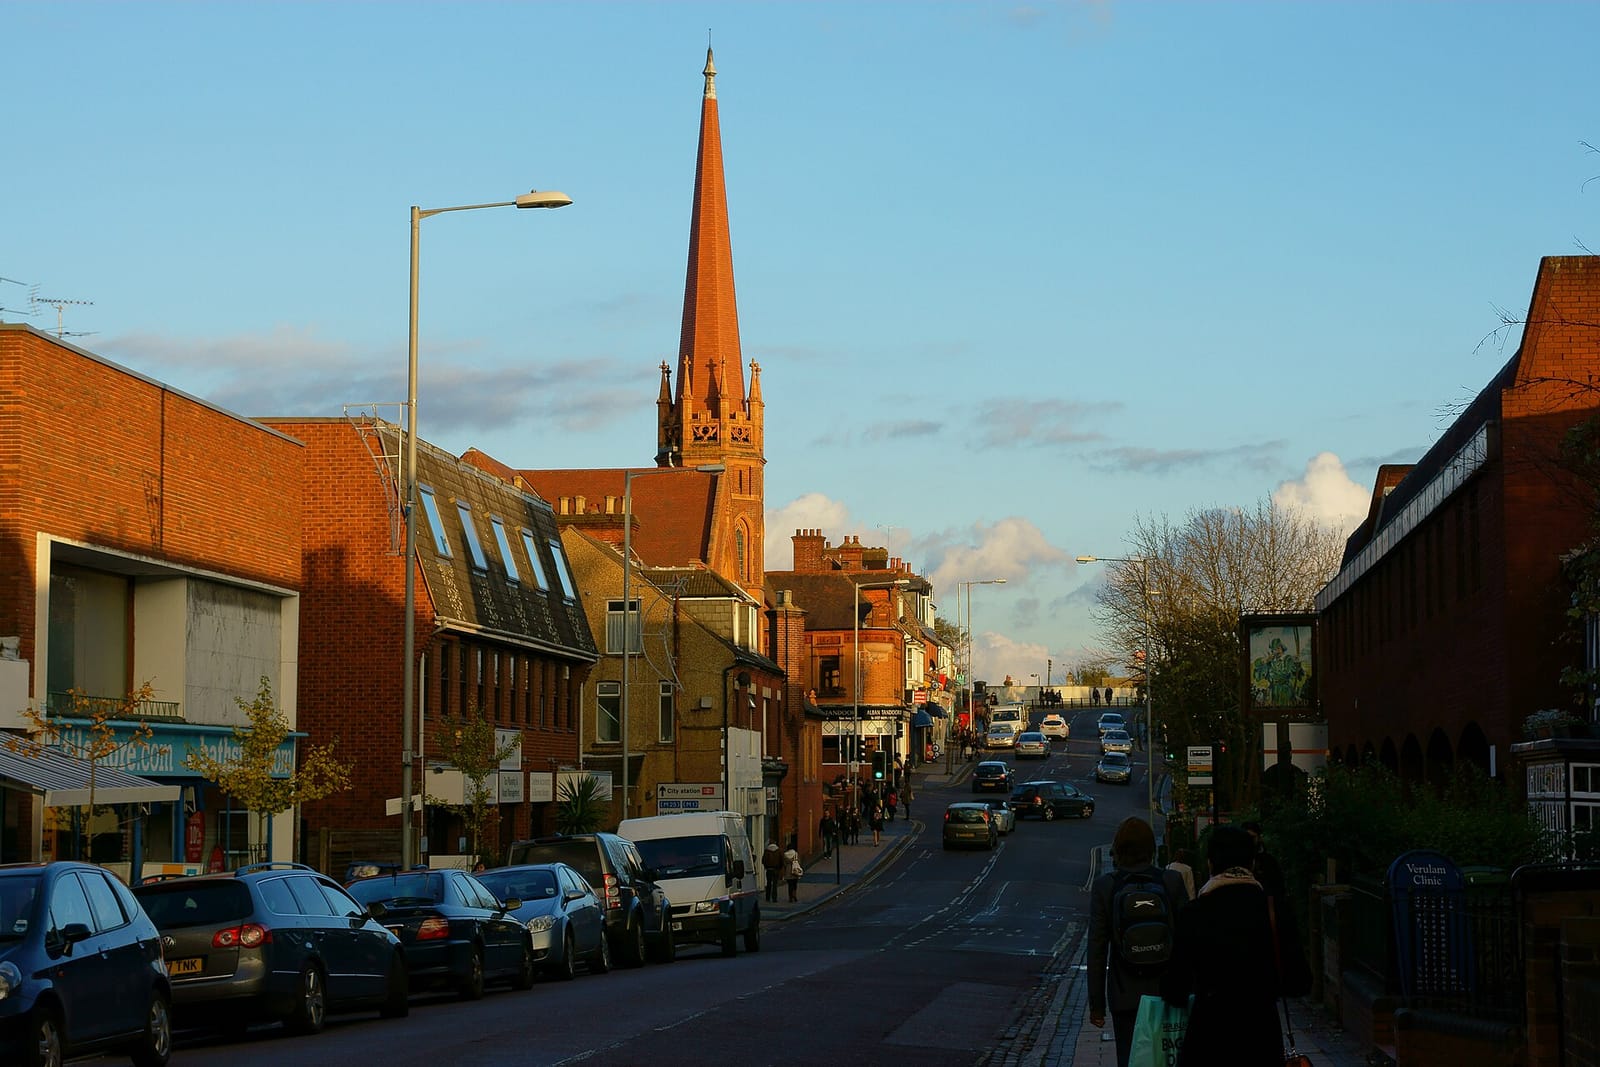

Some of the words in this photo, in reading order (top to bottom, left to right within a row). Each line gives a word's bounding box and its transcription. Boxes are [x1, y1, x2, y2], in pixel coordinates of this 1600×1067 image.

[63, 728, 173, 772] tileore.com
[1406, 863, 1447, 874] Verulam
[1413, 874, 1442, 886] Clinic
[1131, 943, 1166, 953] Slazenge
[177, 959, 198, 972] TNK
